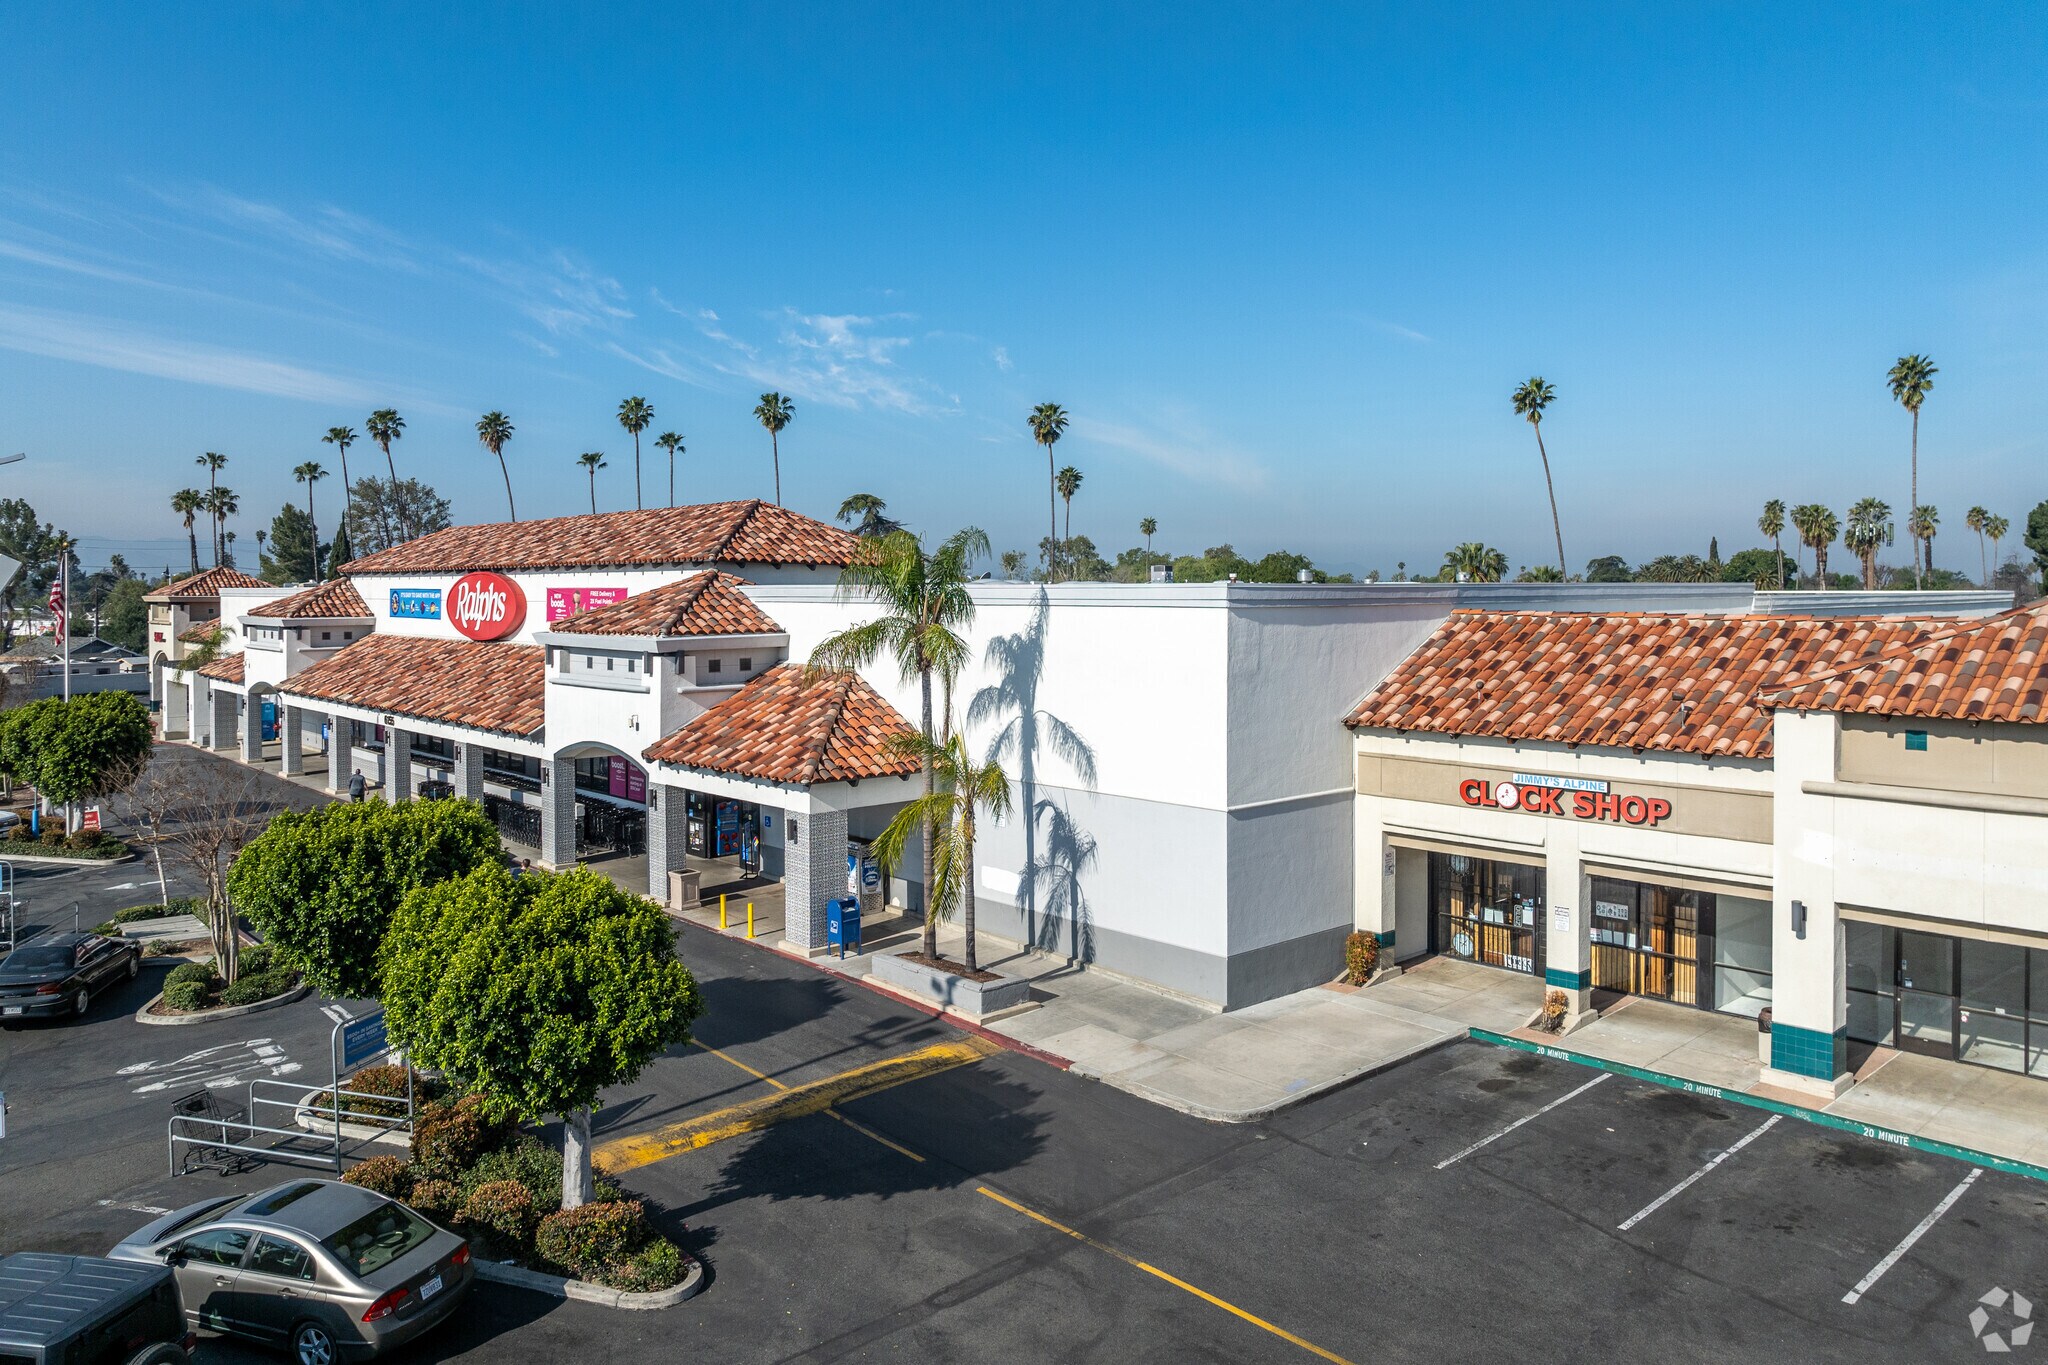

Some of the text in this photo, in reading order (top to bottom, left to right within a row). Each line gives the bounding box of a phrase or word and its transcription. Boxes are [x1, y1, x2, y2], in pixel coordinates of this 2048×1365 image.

[455, 580, 506, 630] Ralphs
[1514, 774, 1605, 792] JIMMY'S ALPINE
[1459, 779, 1671, 826] CLOCK SHOP
[1536, 1046, 1569, 1061] 20 MINUTE
[1683, 1082, 1722, 1099] 20 MINUTE
[1863, 1127, 1910, 1147] 20 MINUTE
